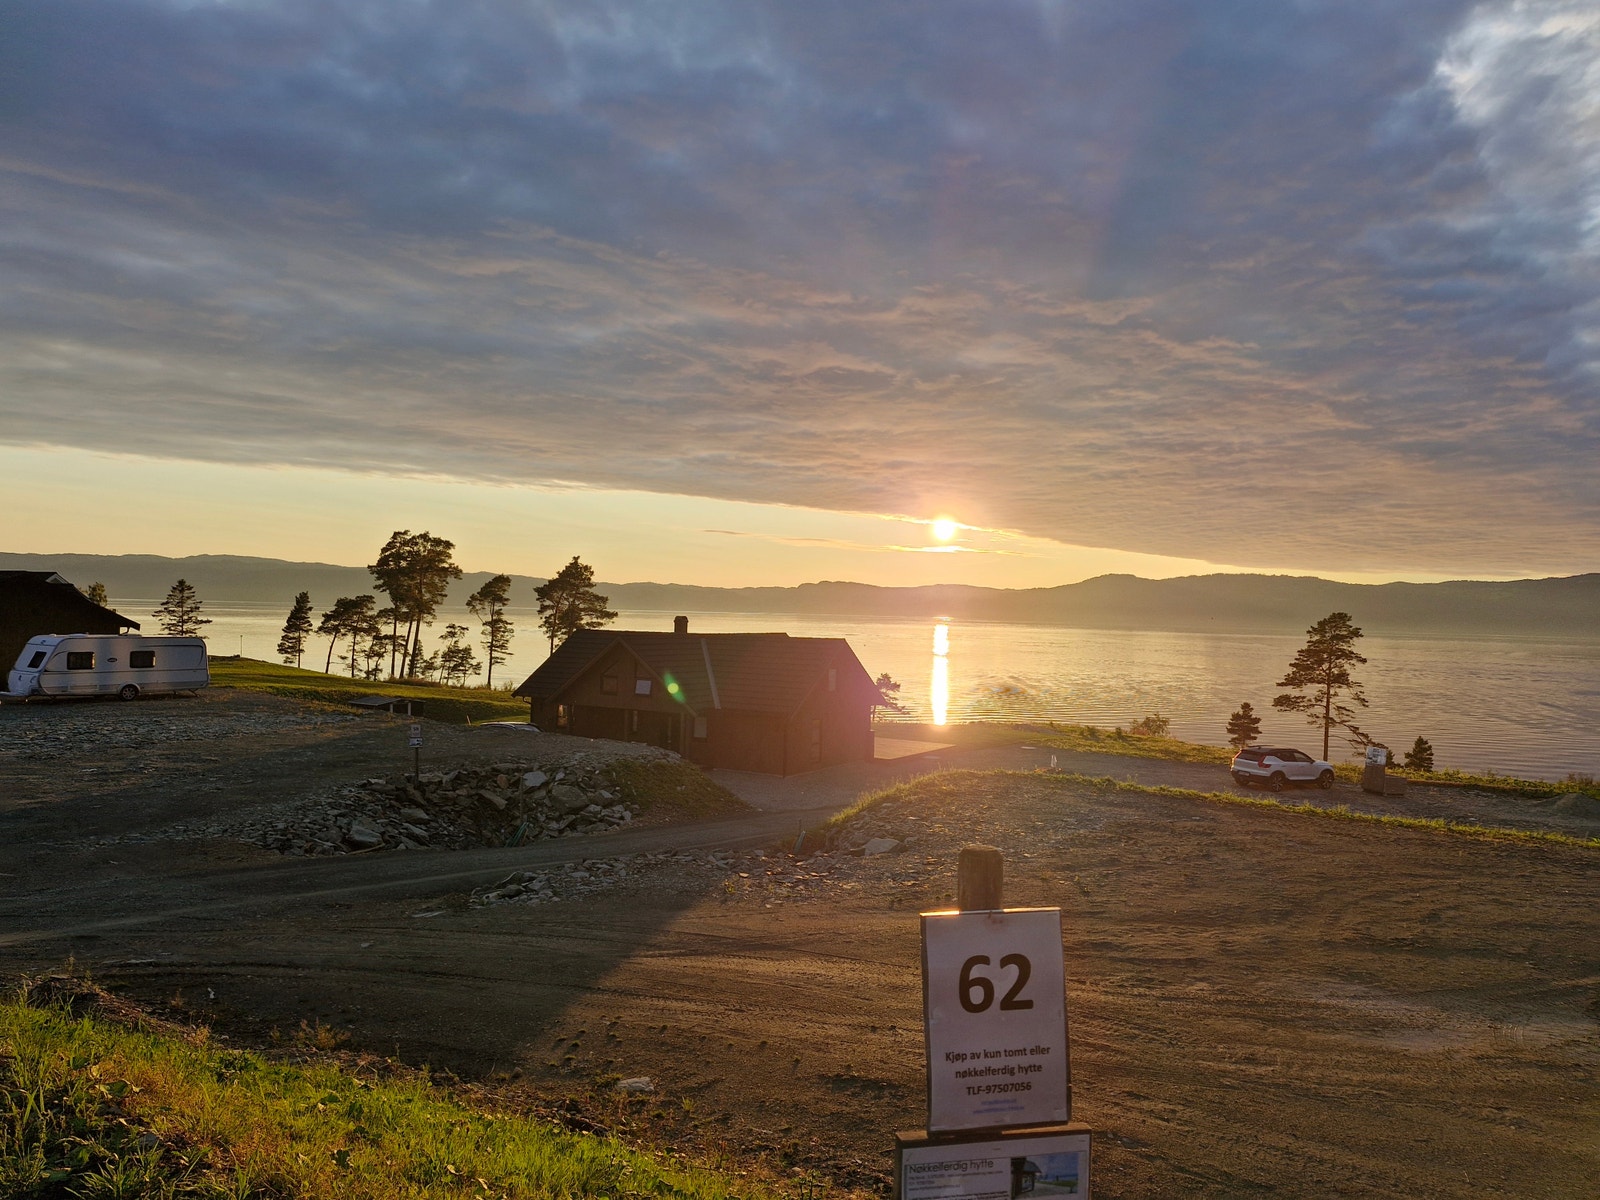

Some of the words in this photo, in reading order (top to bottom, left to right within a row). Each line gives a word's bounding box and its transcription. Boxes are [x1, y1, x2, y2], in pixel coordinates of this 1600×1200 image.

[958, 953, 1034, 1014] 62
[945, 1051, 967, 1063] Kjøp
[970, 1052, 981, 1060] av
[984, 1049, 1001, 1059] kun
[1004, 1047, 1027, 1057] tomt
[1030, 1045, 1051, 1056] eller
[955, 1065, 1015, 1079] nøkkelferdig
[1018, 1063, 1042, 1075] hytte
[966, 1082, 1032, 1095] TLF-97507056
[909, 1161, 968, 1174] Nøkkelferdig
[970, 1159, 994, 1171] hytte
